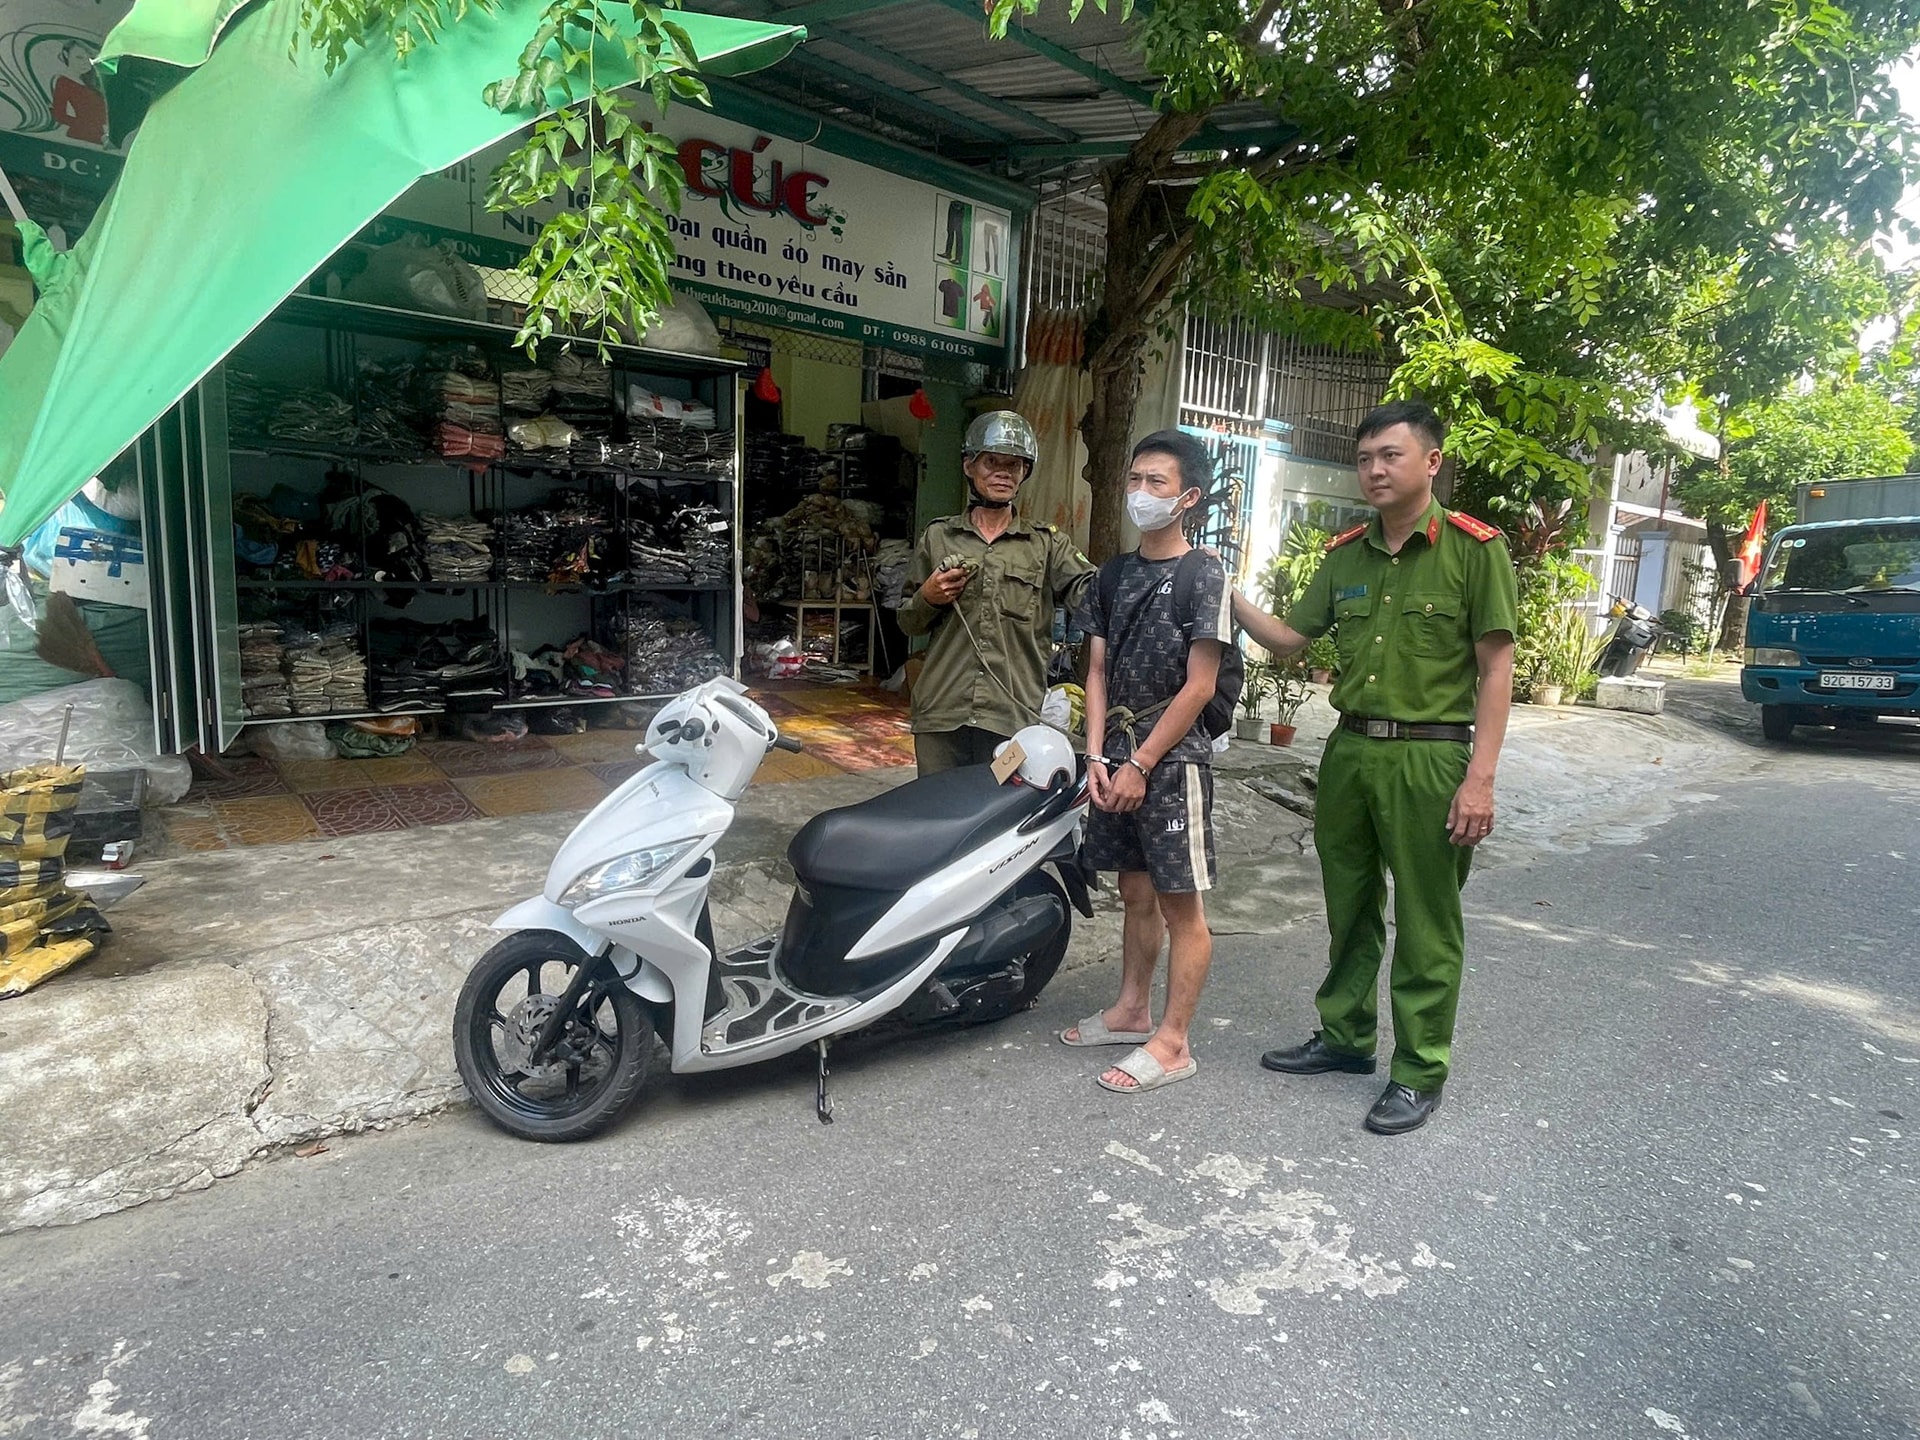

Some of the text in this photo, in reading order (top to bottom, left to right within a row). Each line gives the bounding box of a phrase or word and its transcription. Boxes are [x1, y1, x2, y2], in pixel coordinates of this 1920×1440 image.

[712, 223, 767, 255] quần
[782, 238, 808, 264] áo
[822, 254, 865, 282] may
[716, 259, 772, 287] theo
[776, 275, 815, 295] yêu
[821, 281, 858, 307] cầu
[892, 330, 927, 347] 0988
[930, 339, 975, 357] 610158
[989, 837, 1040, 874] VISION
[608, 915, 647, 926] HONDA
